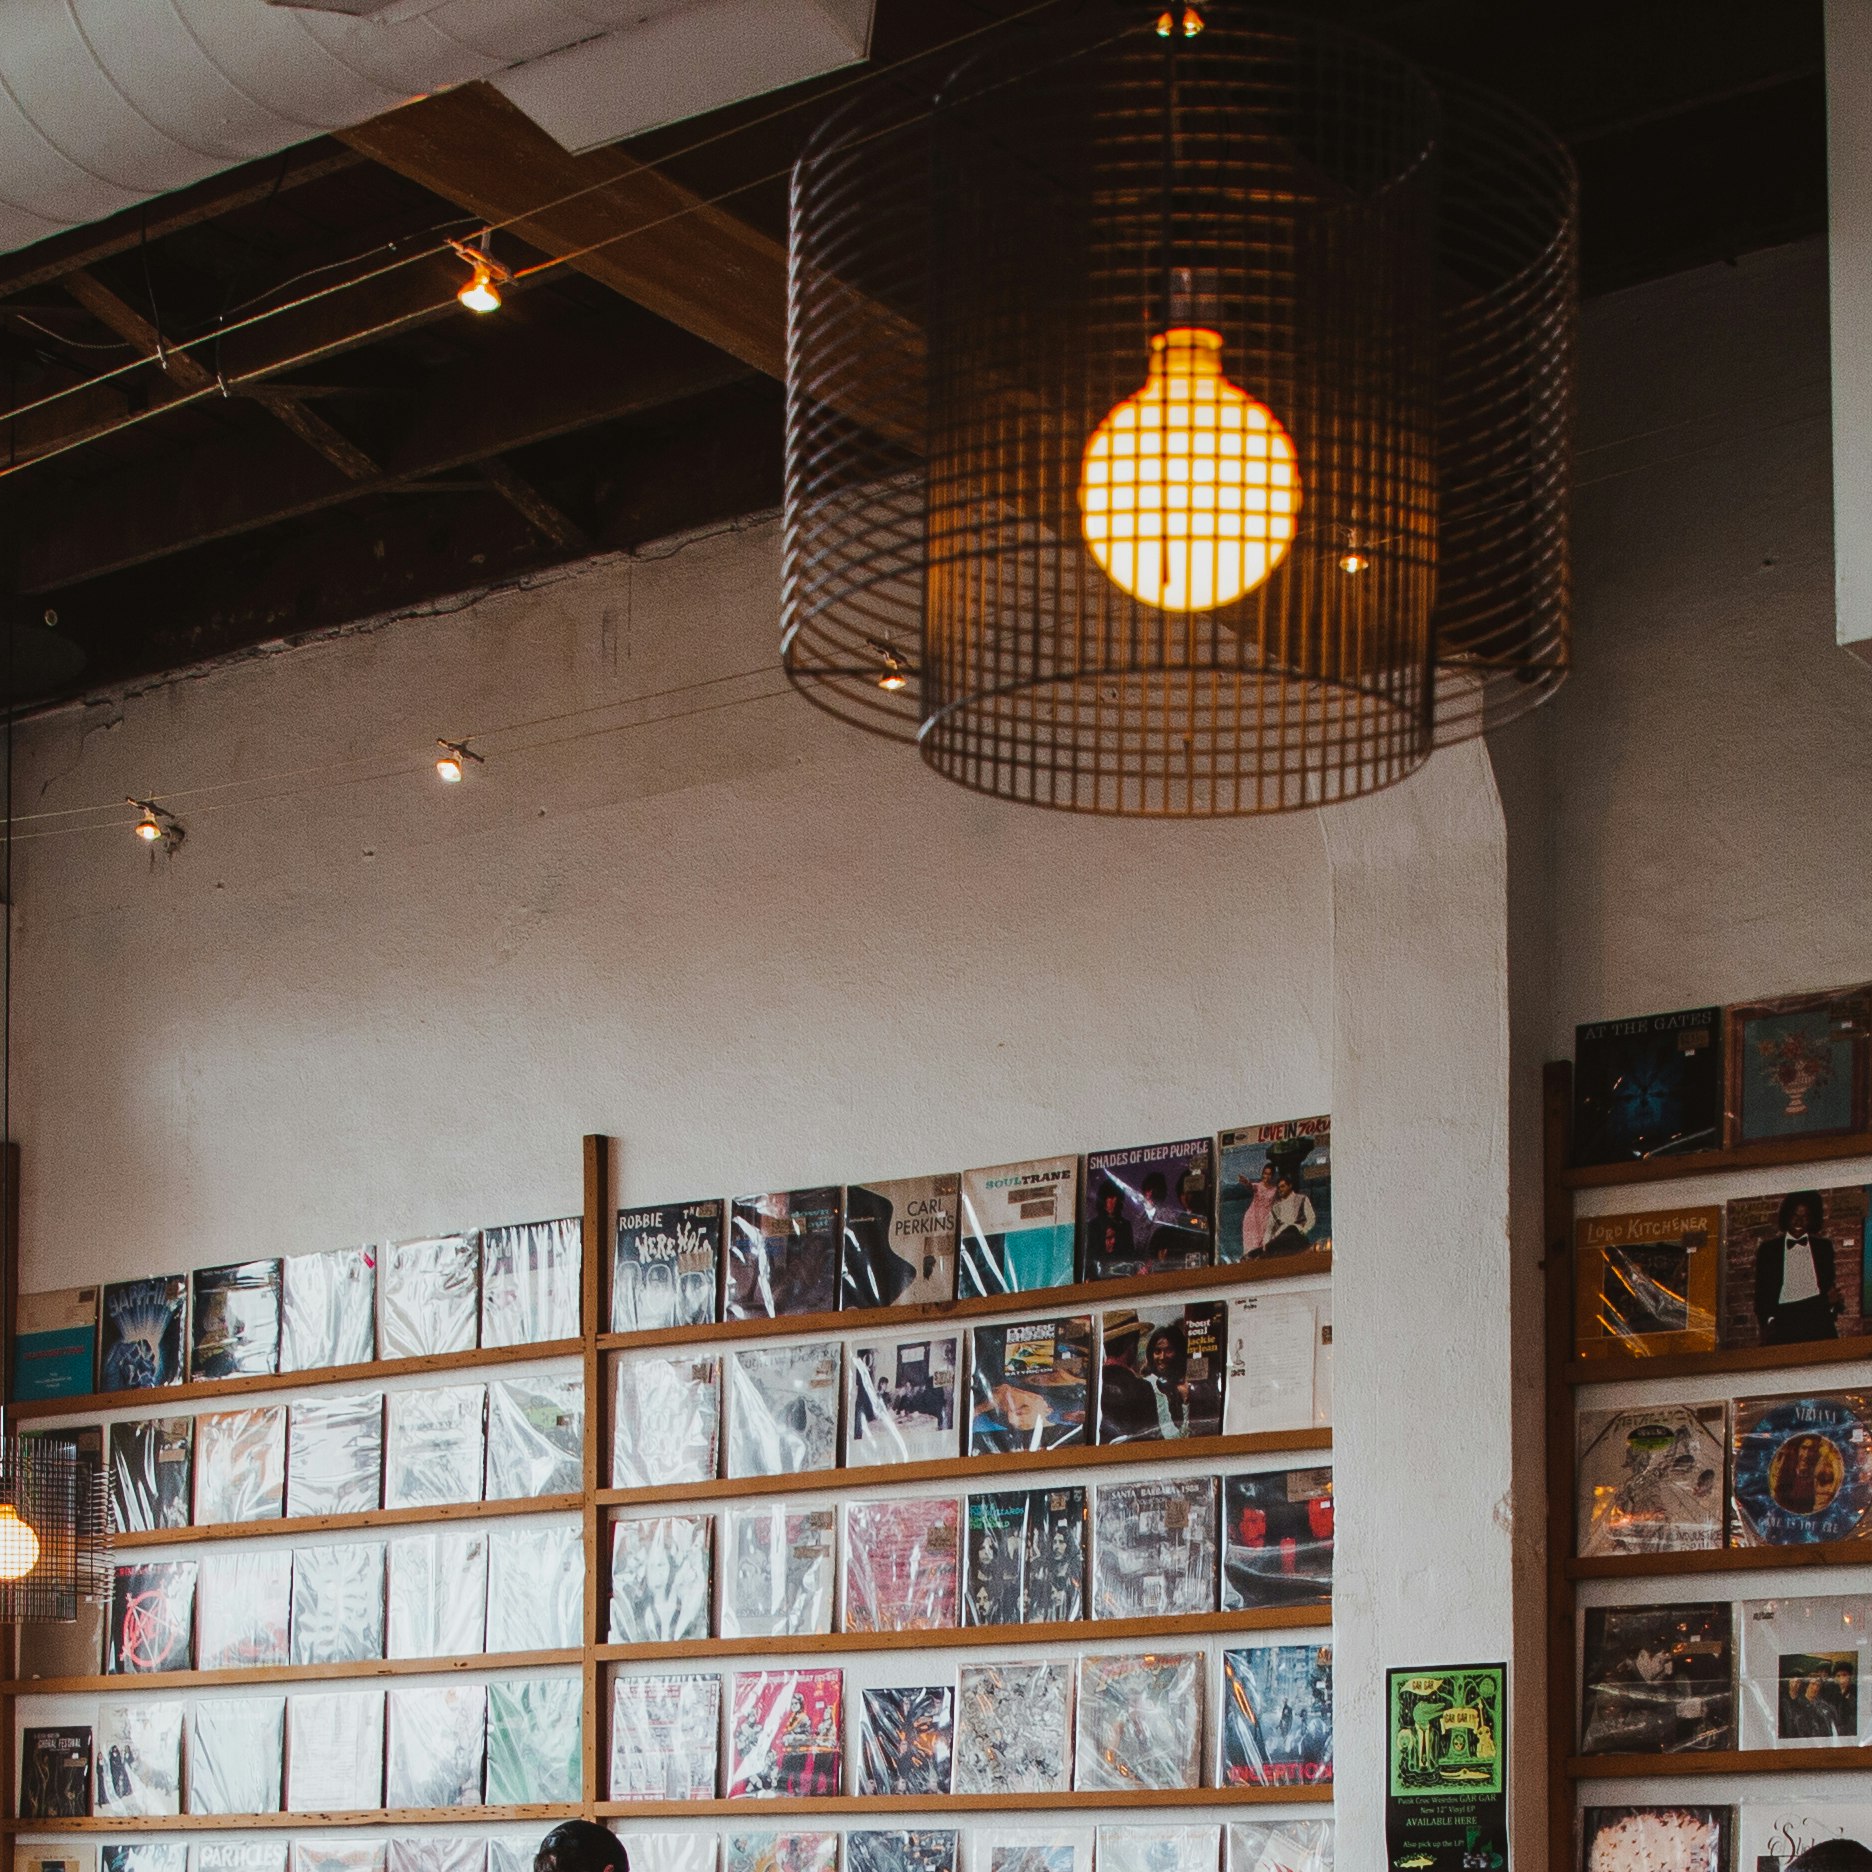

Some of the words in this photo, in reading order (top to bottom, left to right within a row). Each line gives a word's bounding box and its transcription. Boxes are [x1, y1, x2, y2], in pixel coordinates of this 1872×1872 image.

[1584, 1026, 1605, 1041] AT
[1610, 1021, 1648, 1036] THE
[1653, 1012, 1713, 1031] GATES
[1258, 1125, 1283, 1142] LOVE
[1090, 1152, 1126, 1169] SHADES
[1128, 1151, 1142, 1164] OF
[1144, 1147, 1169, 1162] DEEP
[1170, 1141, 1209, 1158] PURPLE
[907, 1199, 943, 1217] CARL
[619, 1212, 663, 1231] ROBBIE
[895, 1215, 955, 1236] PERKINS
[1588, 1219, 1623, 1242] LORD
[1627, 1217, 1709, 1238] KITCHENER
[1406, 1818, 1453, 1827] AVAILABLE
[1454, 1817, 1477, 1825] HERE
[199, 1844, 284, 1866] PARTICLES
